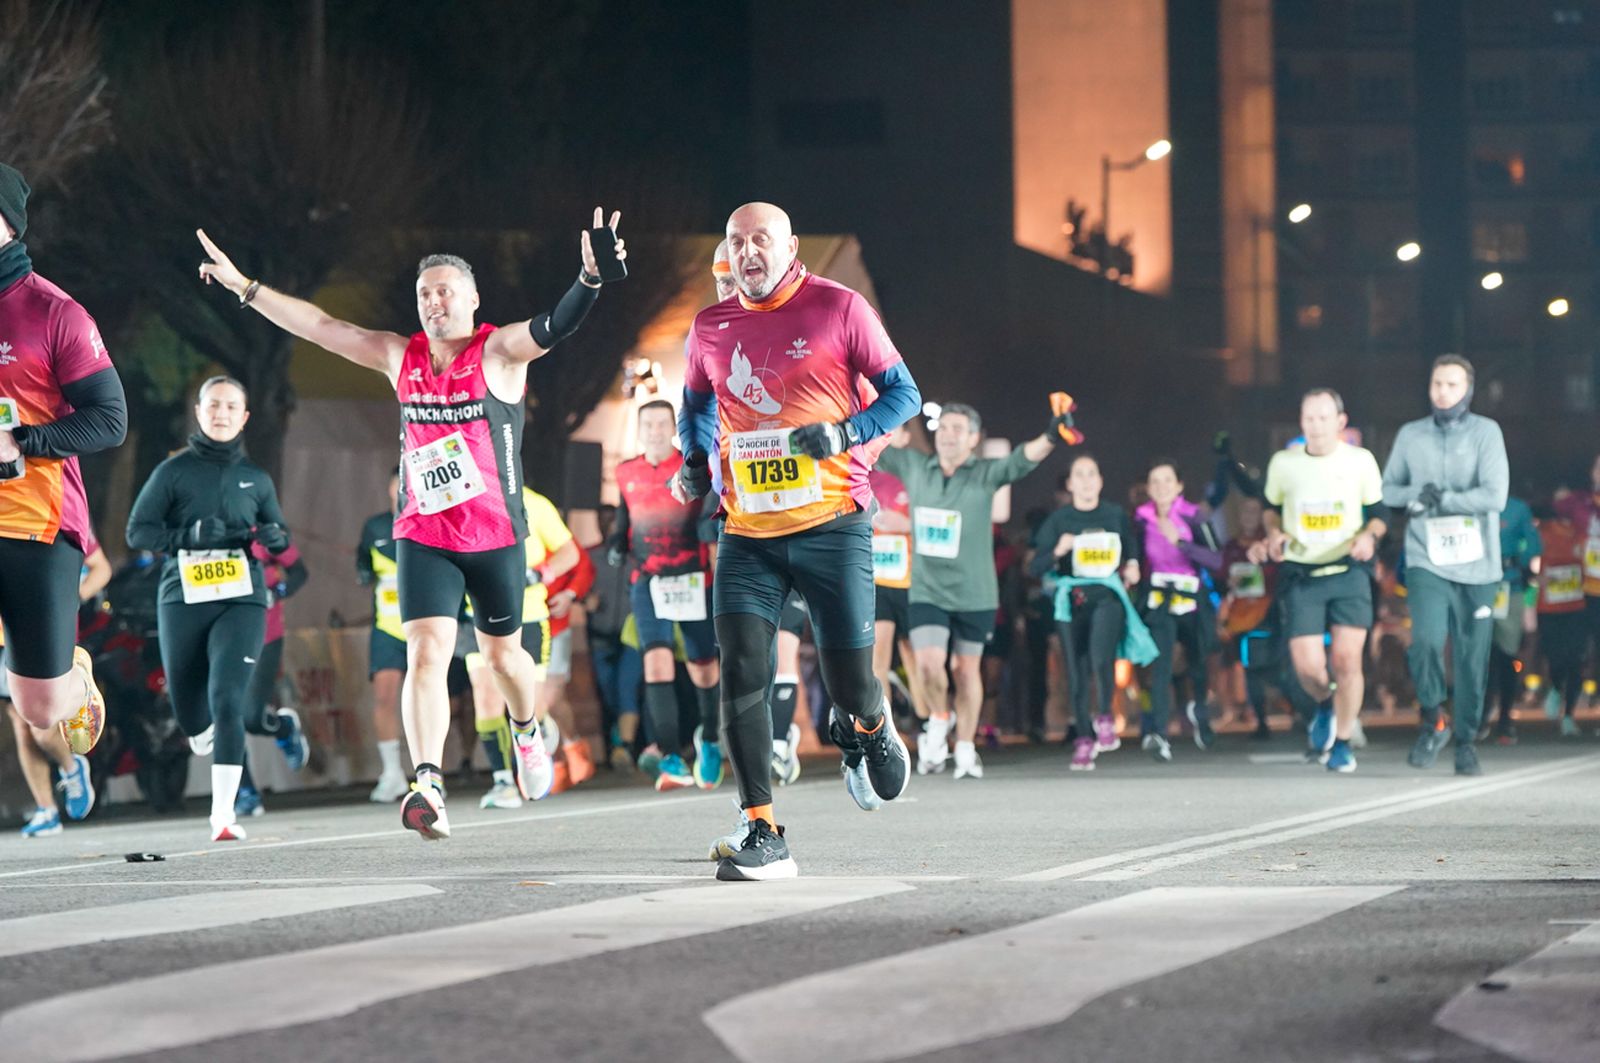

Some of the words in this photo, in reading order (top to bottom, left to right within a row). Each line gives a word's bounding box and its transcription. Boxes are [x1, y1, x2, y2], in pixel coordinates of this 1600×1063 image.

[449, 390, 470, 403] club
[743, 383, 763, 405] 43
[745, 439, 769, 449] NOCHE
[771, 438, 780, 447] DE
[754, 446, 783, 459] ANTÓN
[420, 460, 463, 492] 7208
[747, 458, 799, 485] 1739
[193, 561, 236, 582] 3885
